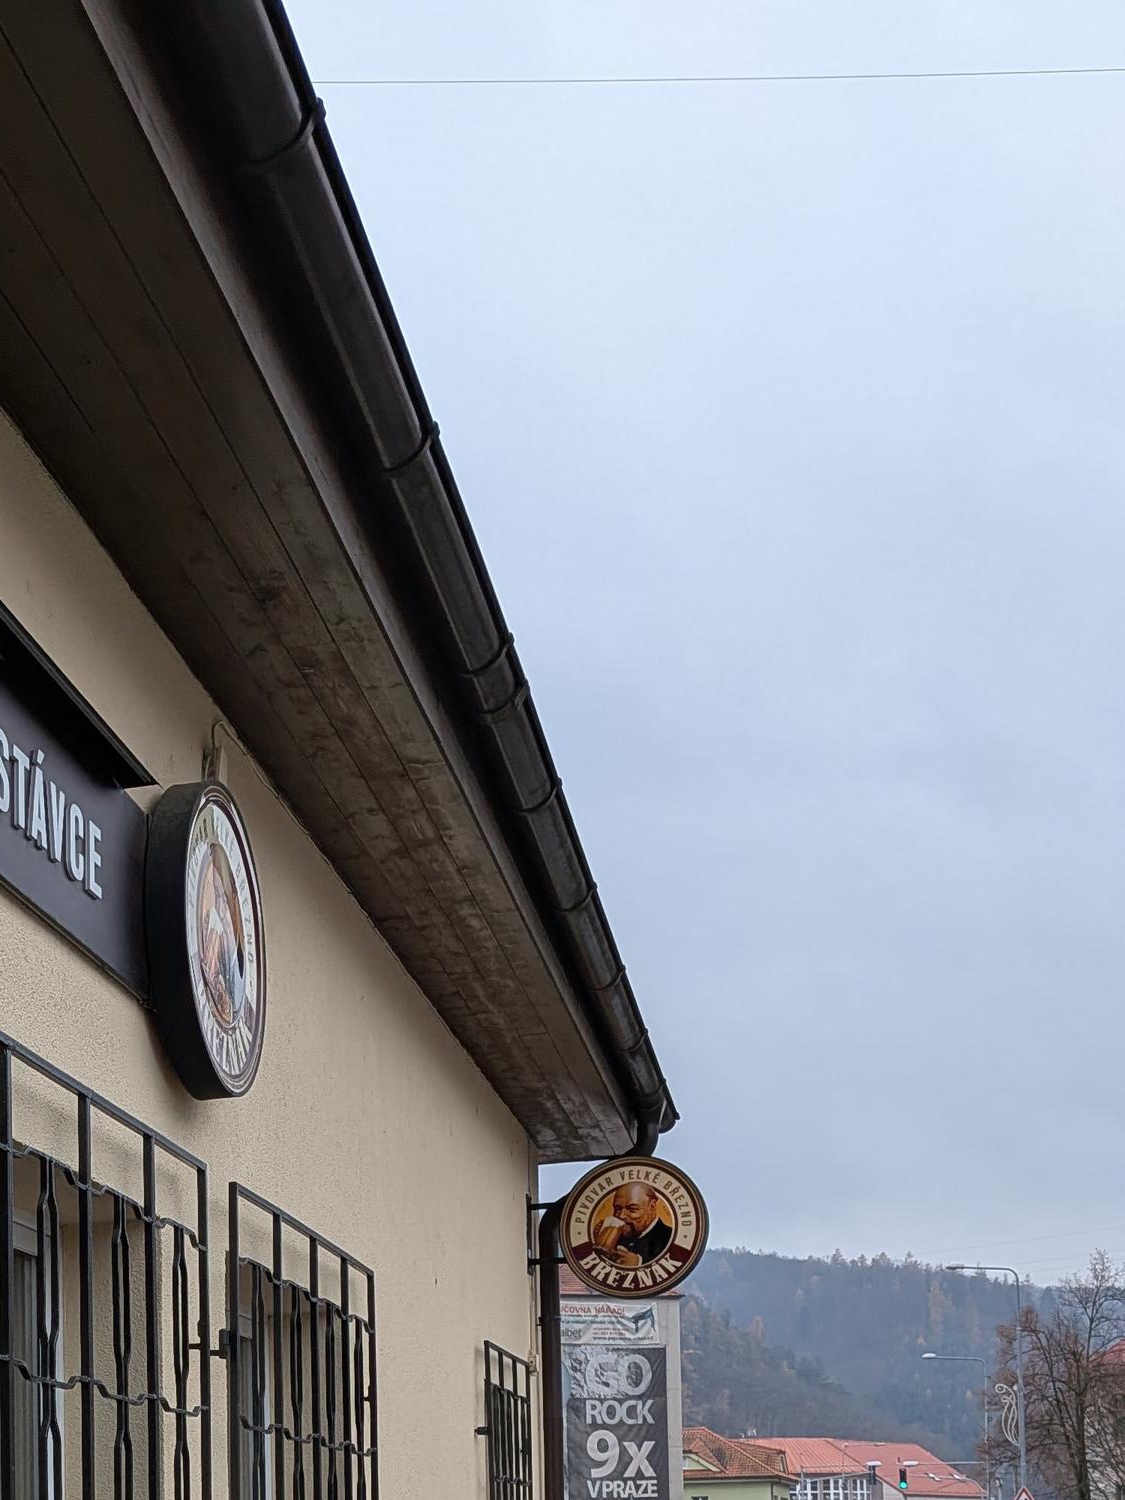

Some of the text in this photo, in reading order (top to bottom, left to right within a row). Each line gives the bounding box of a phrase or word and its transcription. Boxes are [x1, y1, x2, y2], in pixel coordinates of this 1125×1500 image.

[575, 1169, 692, 1227] PIVOVAR VELKÉ BŘEZNO
[579, 1252, 683, 1289] BŘEZŇÁK
[585, 1354, 652, 1396] GO
[586, 1400, 655, 1425] ROCK
